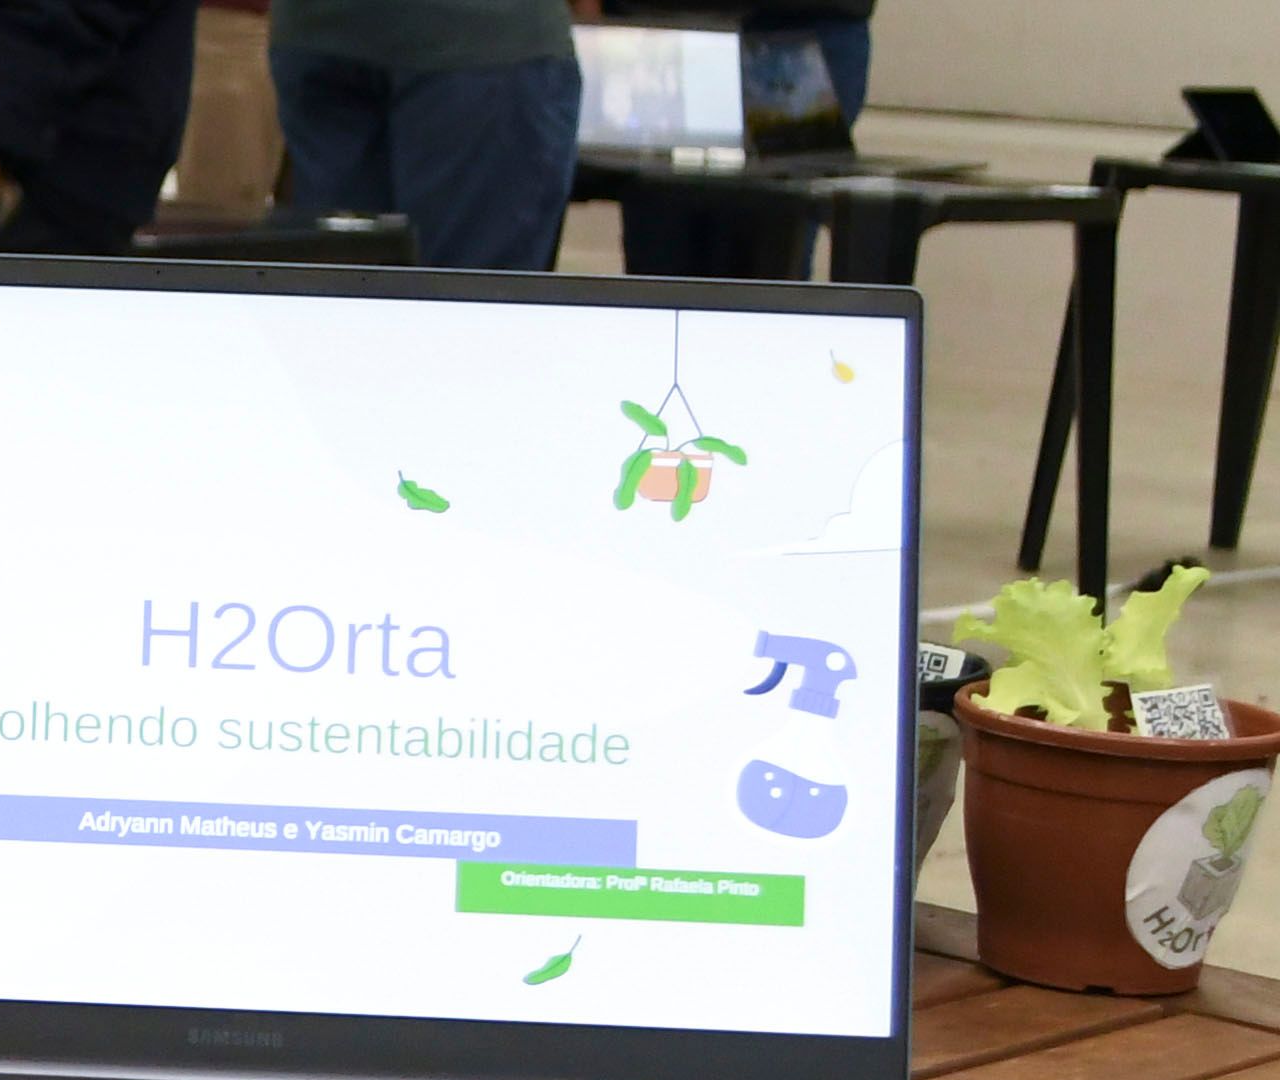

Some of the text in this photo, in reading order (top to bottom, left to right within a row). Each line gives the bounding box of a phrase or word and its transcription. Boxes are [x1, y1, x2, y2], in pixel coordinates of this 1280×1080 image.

[141, 598, 457, 680] H2Orta
[216, 715, 632, 766] sustentabilidade
[78, 810, 502, 853] Adryann Matheus e Yasmin Camargo
[500, 869, 602, 891] Orientadora:
